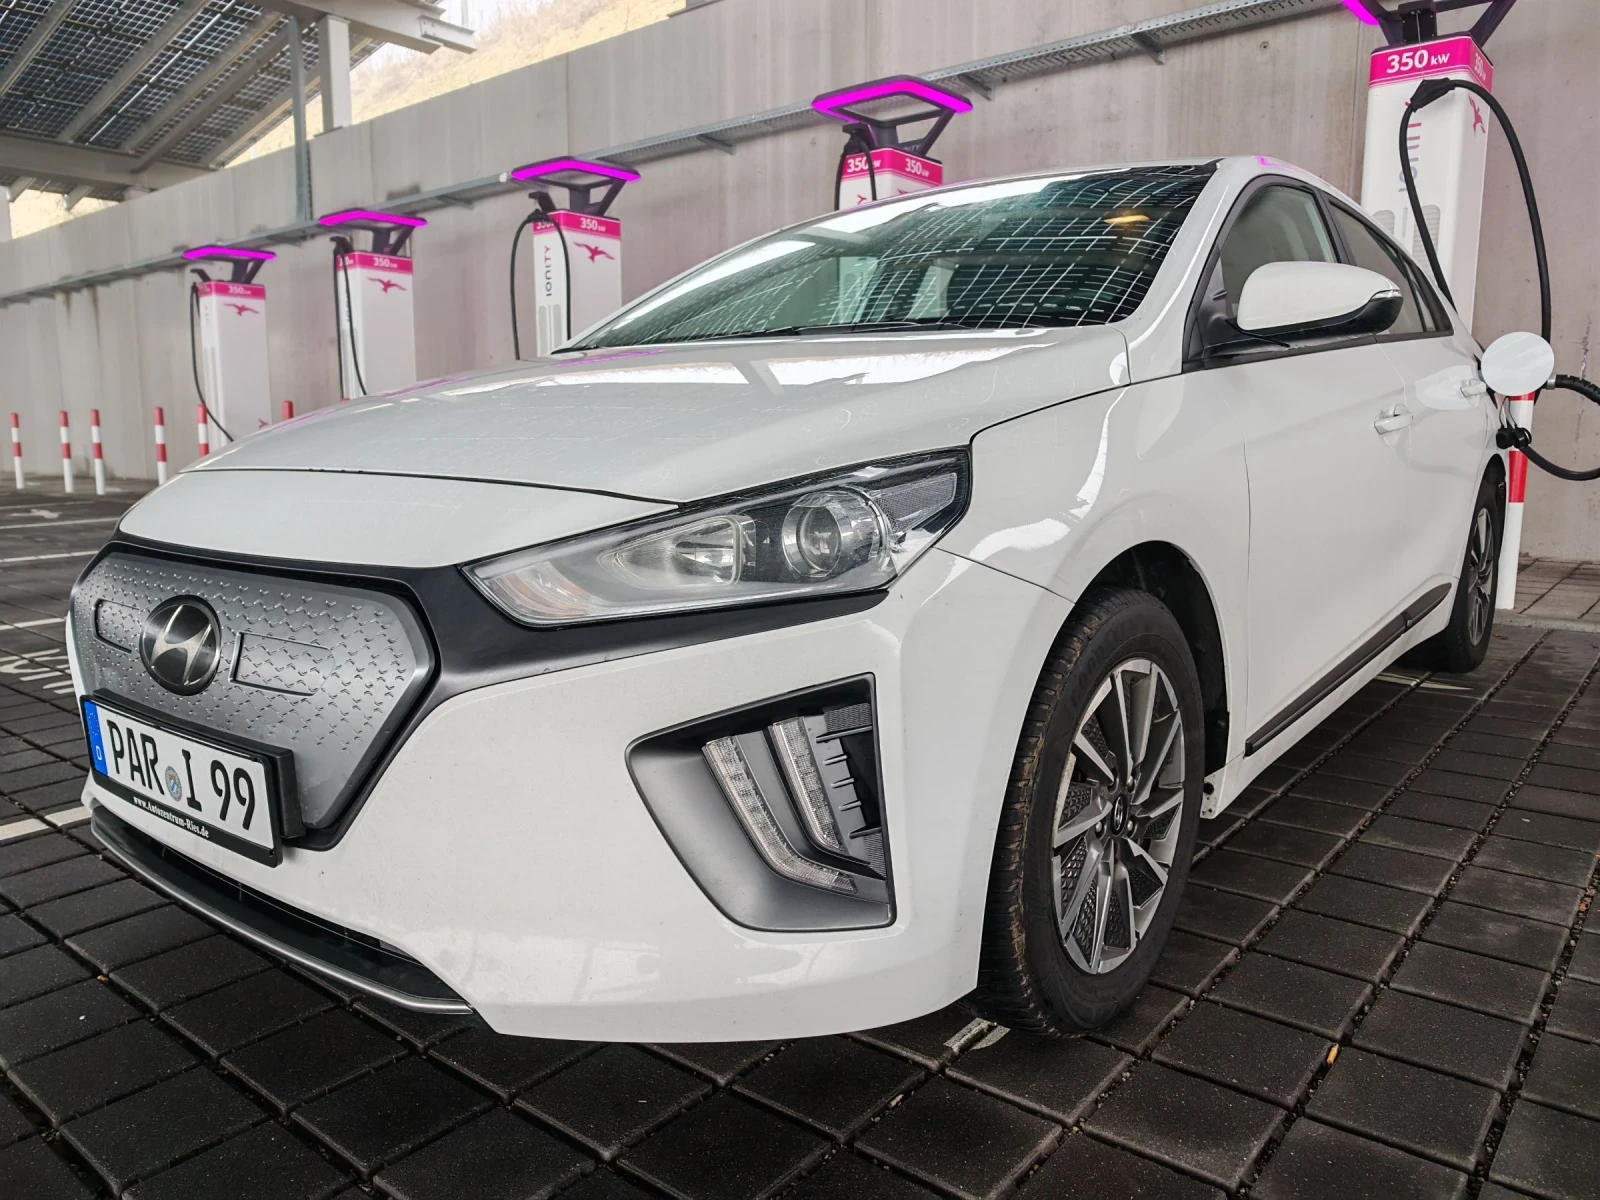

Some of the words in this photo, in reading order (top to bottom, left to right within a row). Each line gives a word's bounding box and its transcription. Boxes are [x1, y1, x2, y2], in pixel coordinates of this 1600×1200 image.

[1386, 49, 1428, 74] 350
[1430, 53, 1450, 66] kW
[905, 158, 922, 174] 350
[580, 217, 598, 231] 350
[373, 256, 390, 267] 350
[544, 246, 552, 297] IONITY
[227, 284, 244, 295] 350
[96, 745, 102, 761] D
[106, 719, 165, 796] PAR
[181, 748, 202, 812] I
[210, 759, 256, 831] 99
[132, 796, 210, 839] www.Autozentrum-Ries.de
